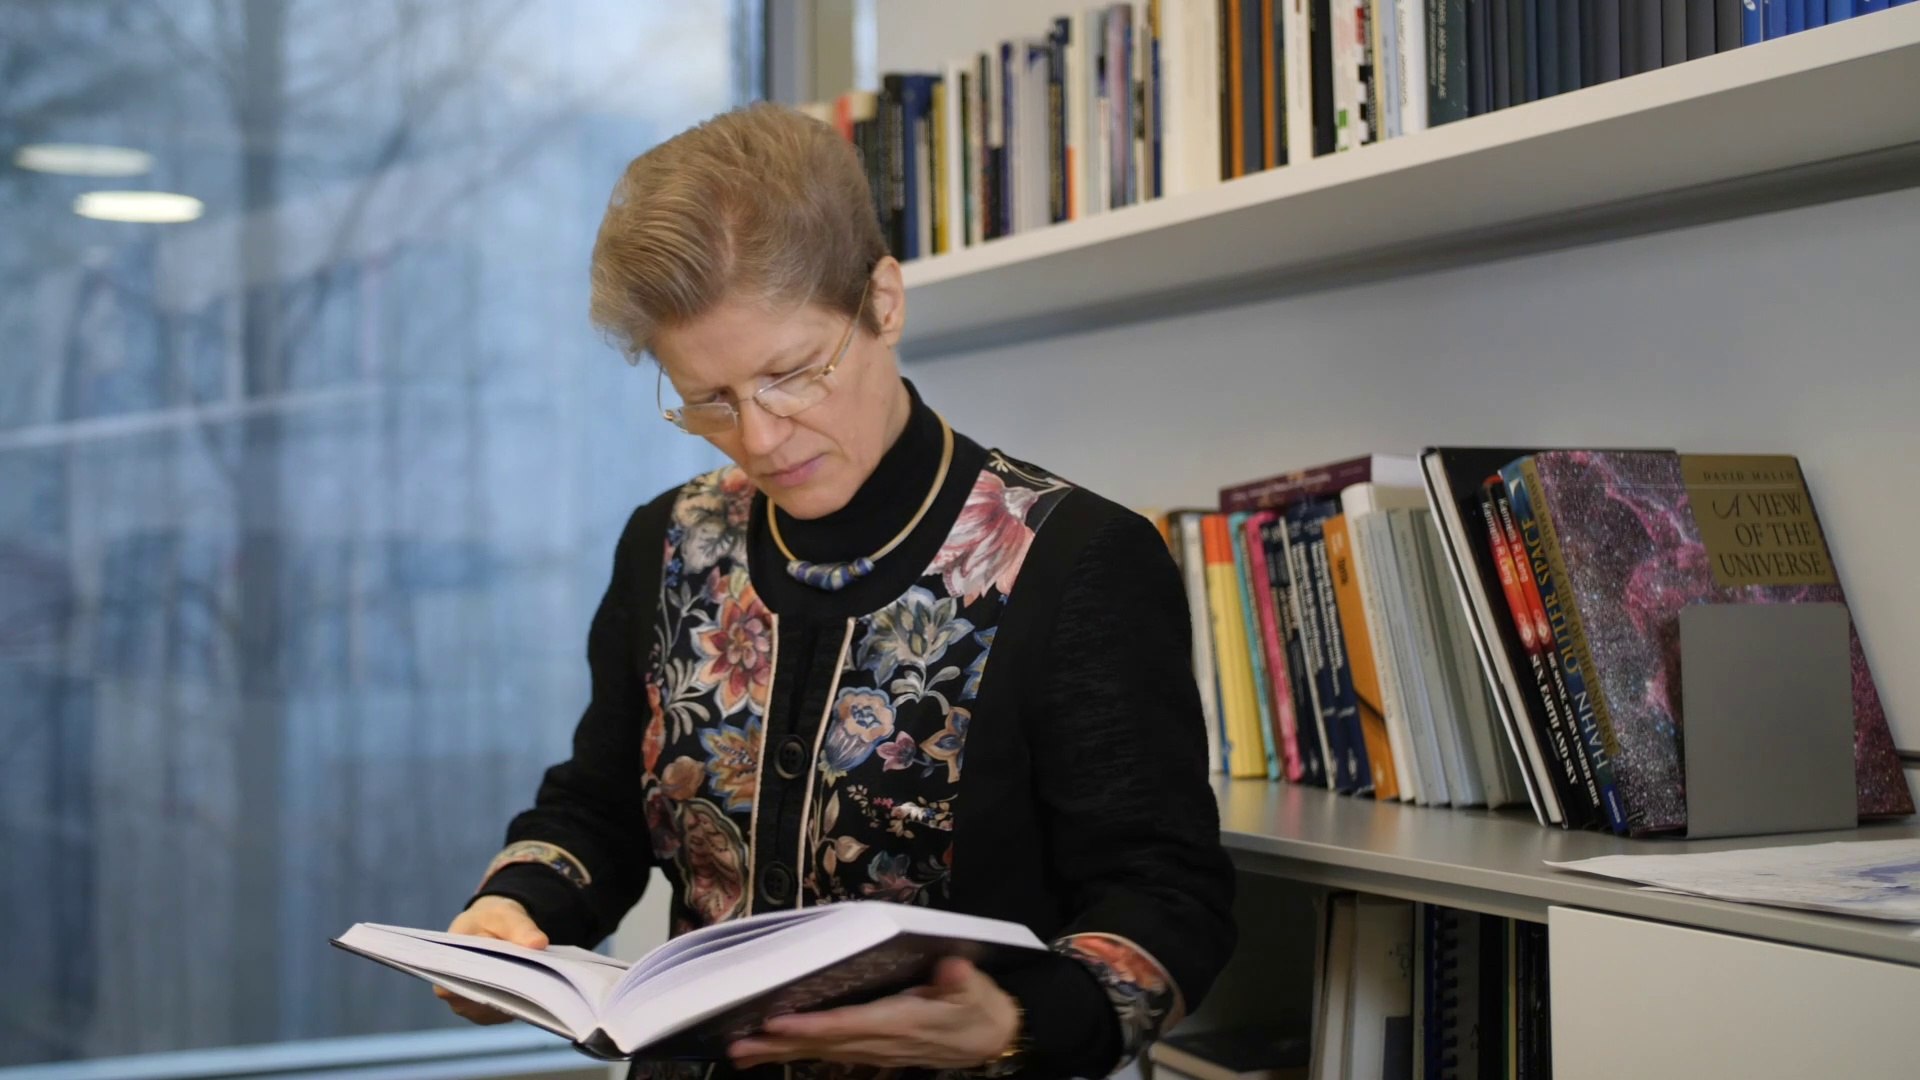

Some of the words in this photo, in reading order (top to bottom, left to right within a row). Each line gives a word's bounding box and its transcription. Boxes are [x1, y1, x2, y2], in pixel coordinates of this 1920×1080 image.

[1735, 522, 1763, 547] OF
[1766, 522, 1816, 547] THE
[1747, 492, 1802, 517] VIEW
[1522, 519, 1551, 585] SPACE
[1719, 551, 1826, 577] UNIVERSE
[1545, 592, 1578, 673] OUTER
[1575, 645, 1594, 677] THE
[1585, 677, 1617, 749] UNIVERSE
[1575, 691, 1609, 769] HAHN
[1538, 683, 1560, 728] EARTH
[1553, 729, 1570, 759] AND
[1562, 757, 1578, 785] SKY
